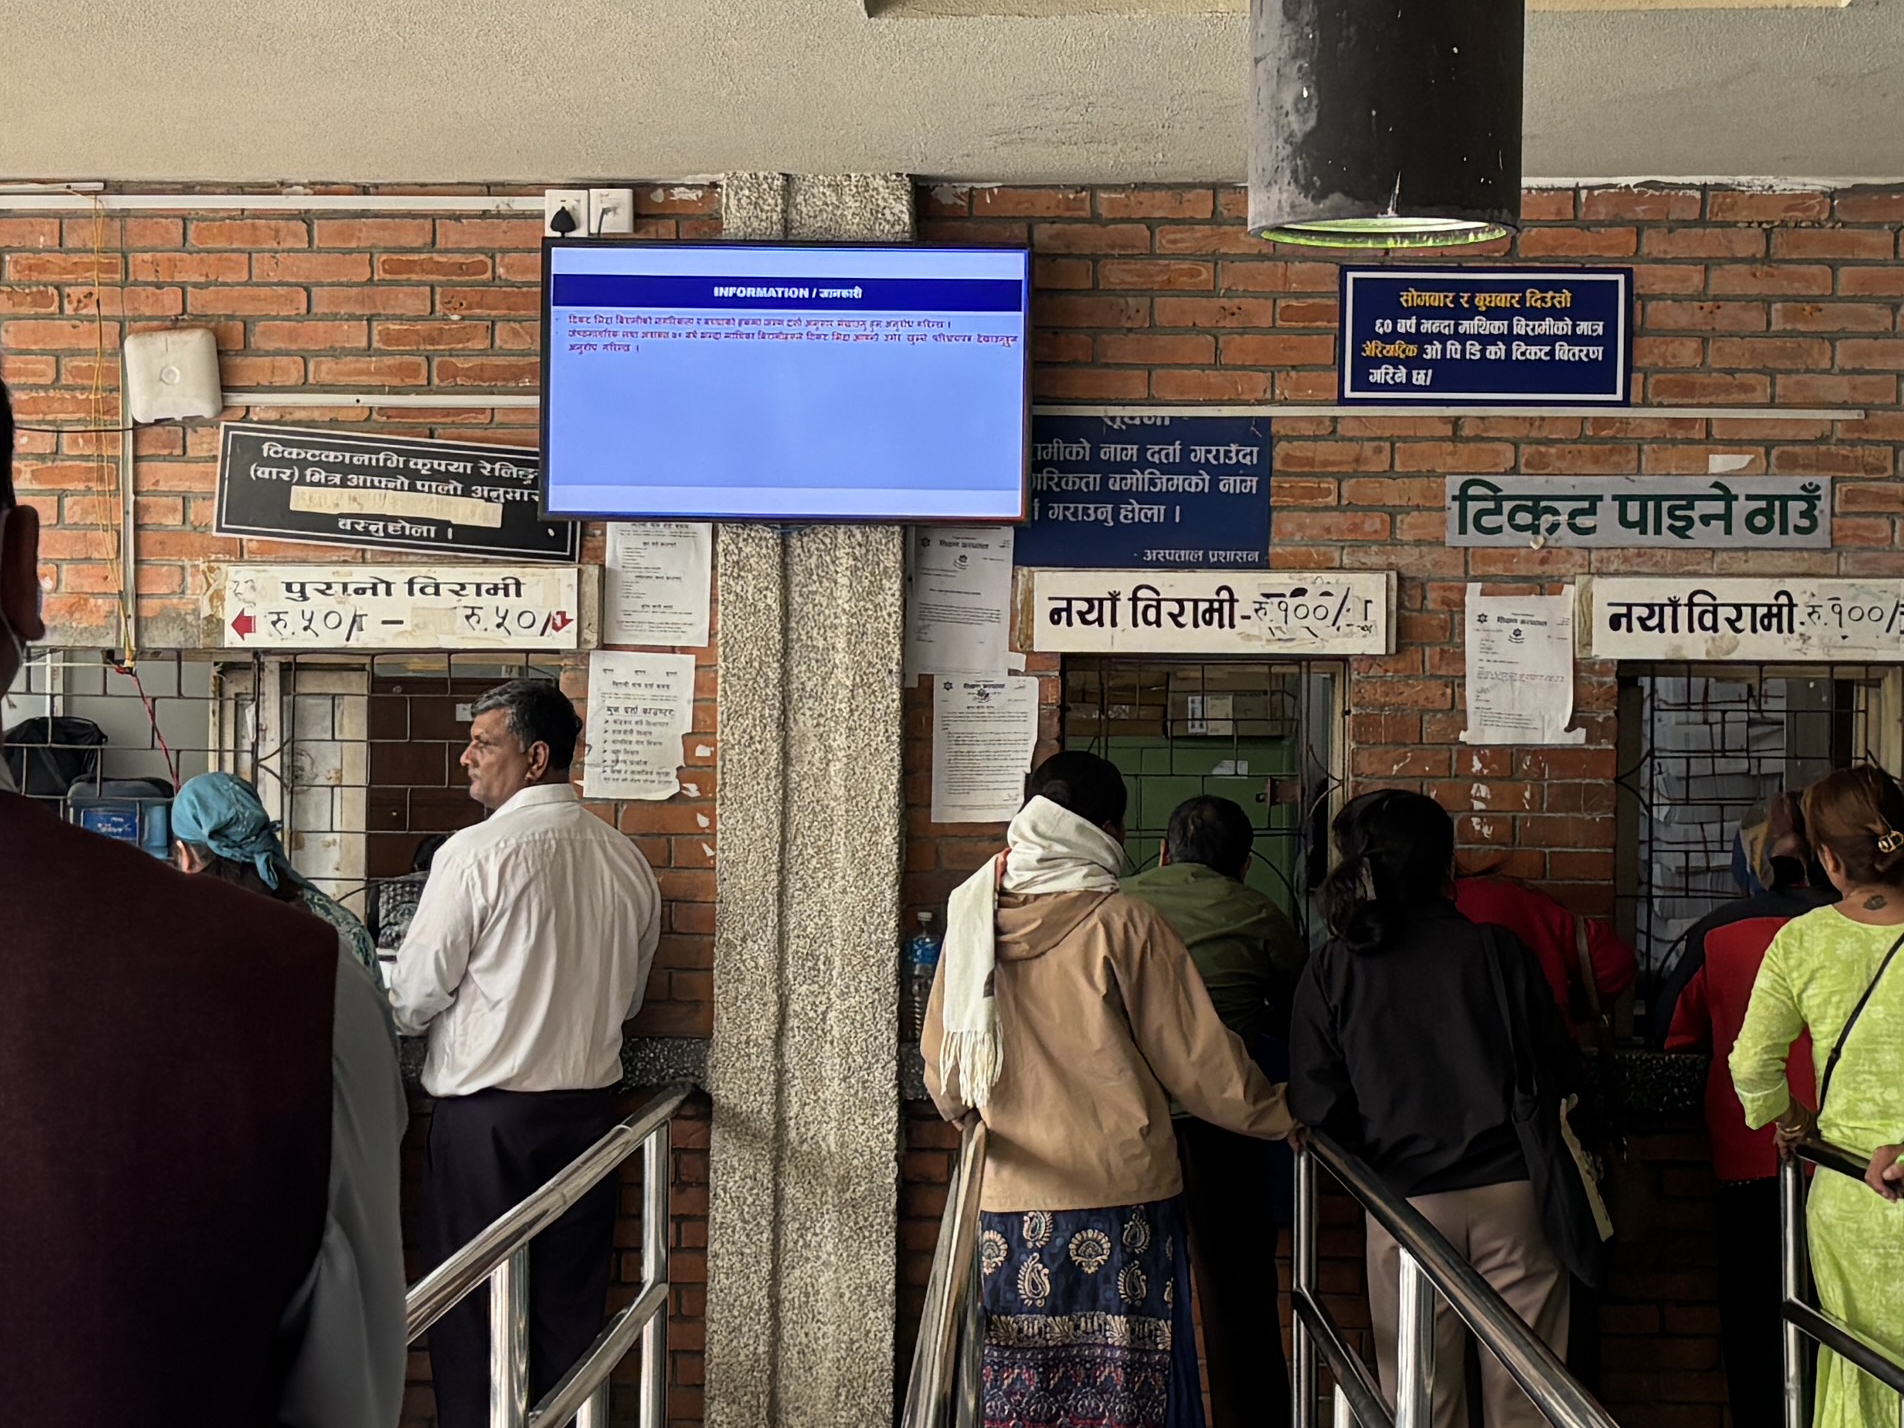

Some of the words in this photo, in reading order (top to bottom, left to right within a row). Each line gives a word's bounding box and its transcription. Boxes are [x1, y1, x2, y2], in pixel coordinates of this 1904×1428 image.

[714, 286, 810, 299] INFORMATION
[1460, 292, 1471, 308] र
[1375, 319, 1393, 335] ६०
[1420, 320, 1455, 336] भन्दा
[1458, 315, 1508, 336] माथिका
[1576, 320, 1604, 337] मात्र
[1422, 340, 1442, 360] ओ
[1446, 340, 1462, 360] पि
[1465, 340, 1483, 360] डि
[1486, 341, 1506, 361] को
[1511, 341, 1551, 361] टिकट
[1369, 365, 1407, 385] गरिने
[1100, 443, 1139, 462] नाम
[1146, 440, 1182, 464] दर्ता
[305, 467, 343, 486] भित्र
[1048, 503, 1114, 527] गराउनु
[1119, 499, 1167, 523] होला
[1451, 477, 1604, 536] टिकट
[1611, 480, 1739, 540] पाइने
[1745, 480, 1822, 537] ठाउँ
[1143, 549, 1204, 563] अस्पताल
[1209, 549, 1260, 564] प्रशासन
[281, 575, 396, 602] पुरानो
[1048, 590, 1121, 629] नयाँ
[1607, 595, 1681, 635] नयाँ
